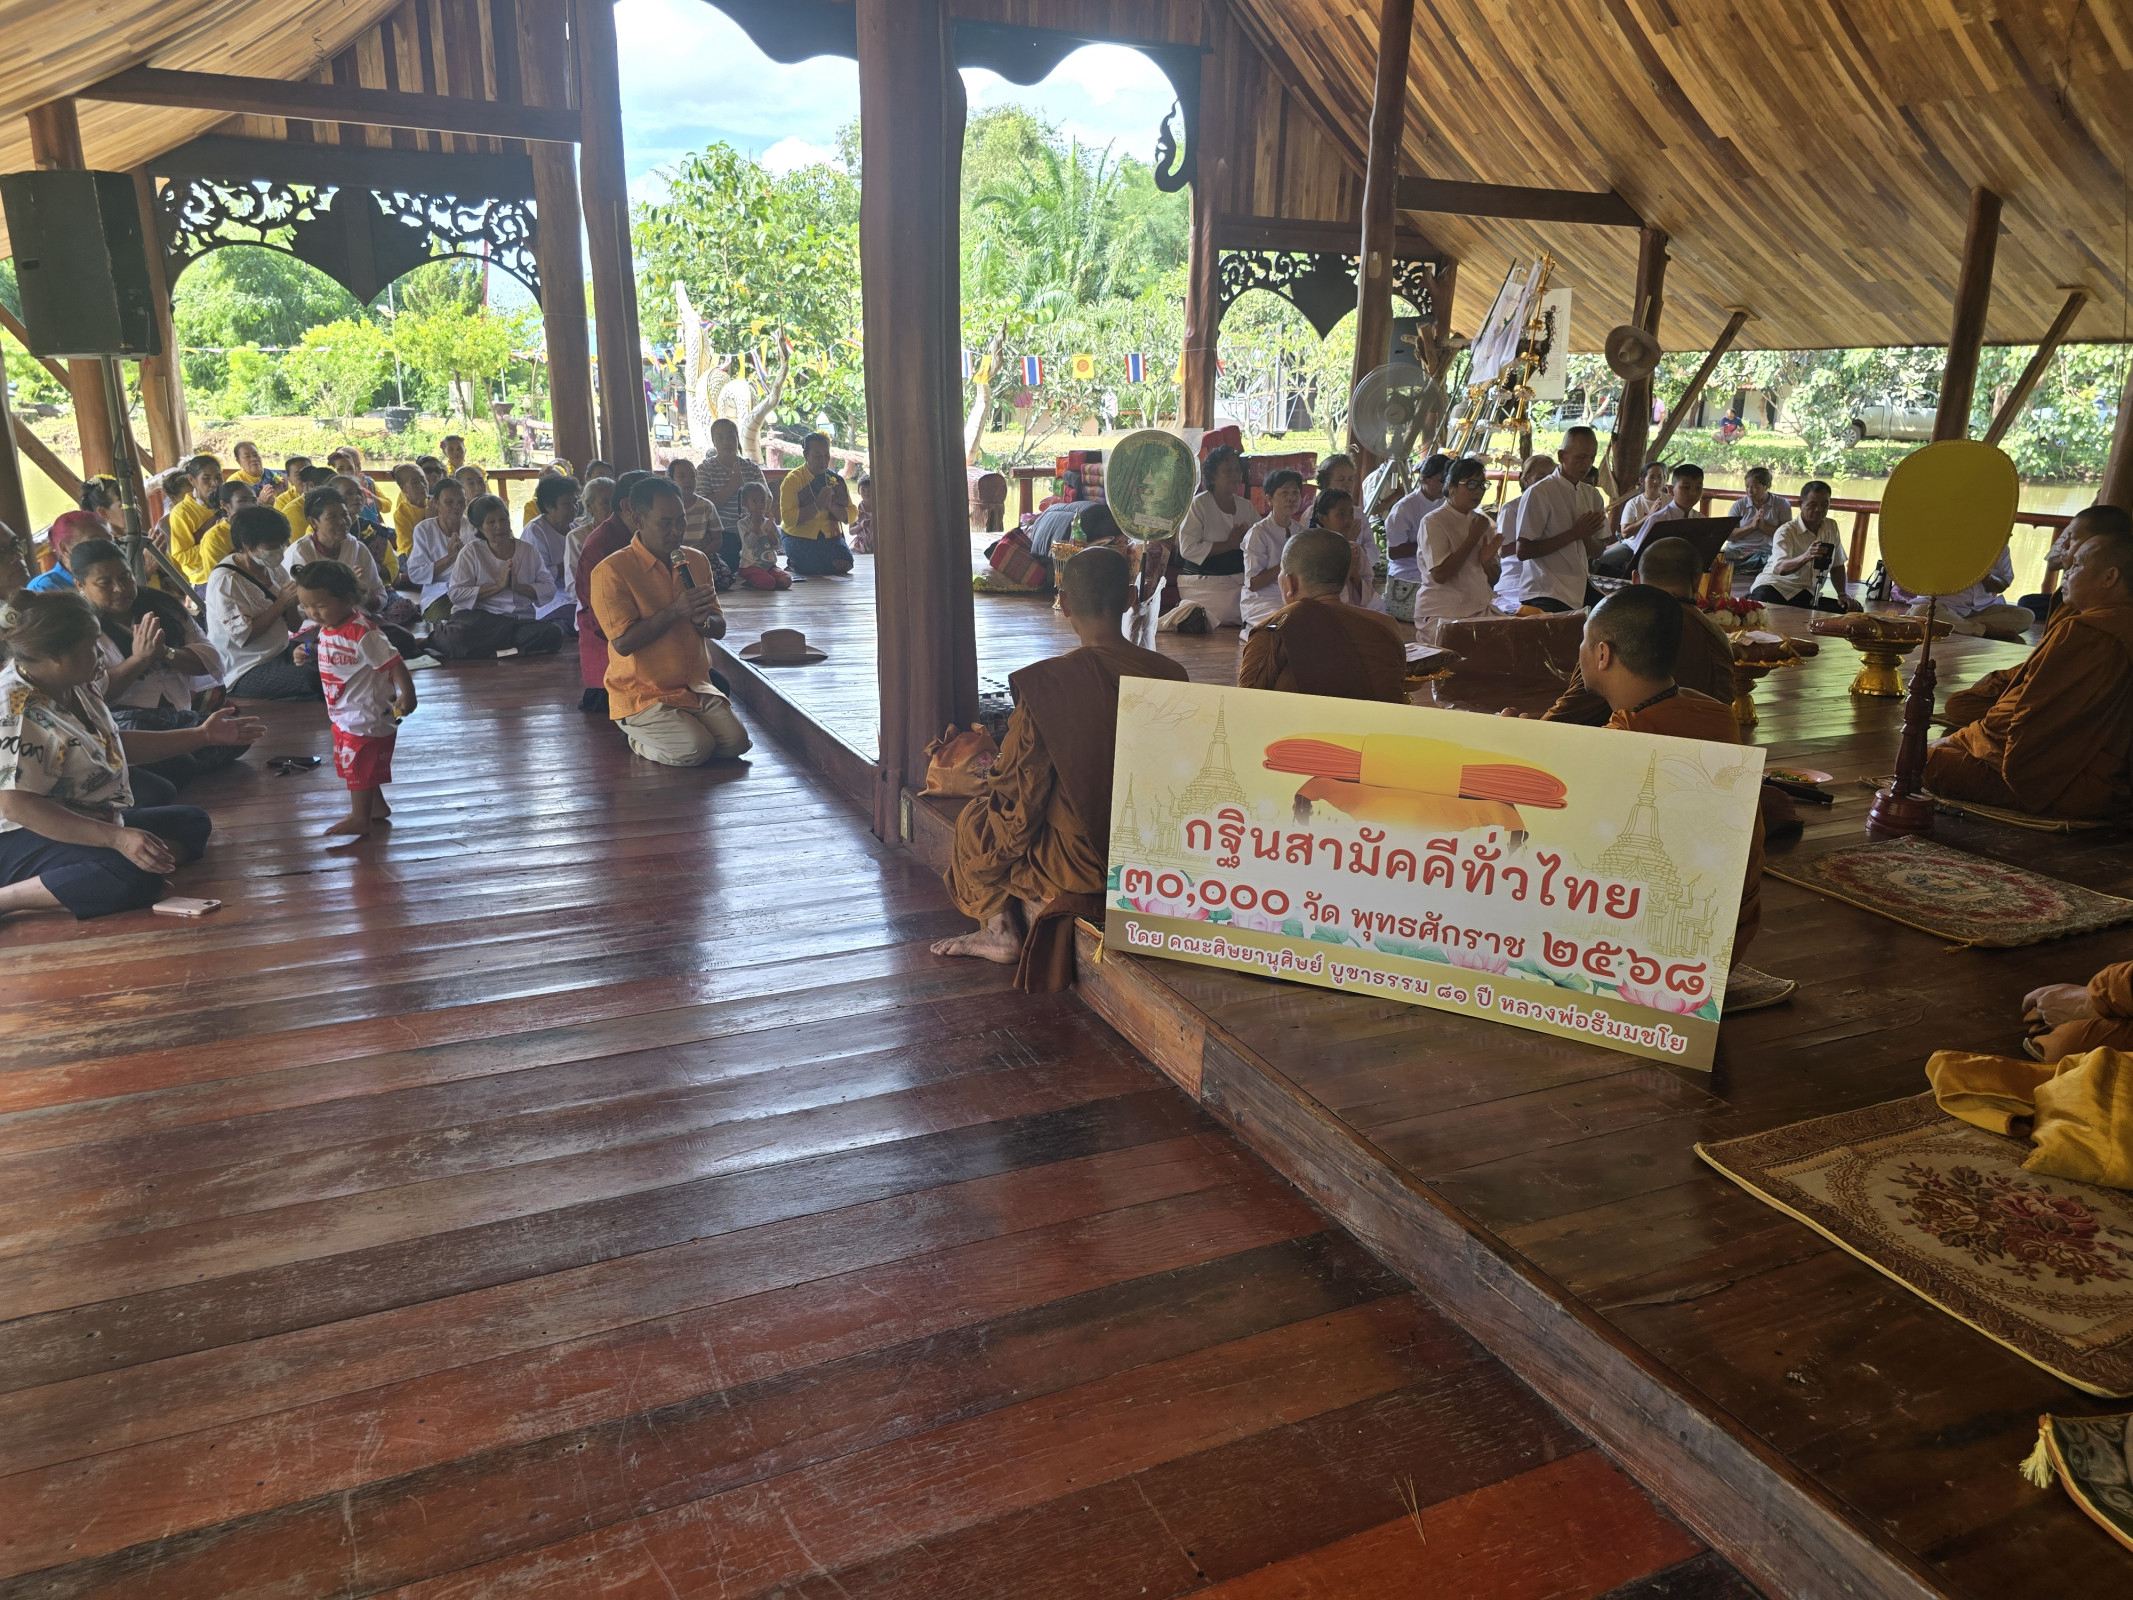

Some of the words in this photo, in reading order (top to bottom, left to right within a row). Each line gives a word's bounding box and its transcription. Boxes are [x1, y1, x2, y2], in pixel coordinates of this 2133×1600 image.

[1185, 807, 1641, 920] กฐินสามัคคีทั่วไทย
[1124, 867, 1290, 916] ๓๐,๐๐๐
[1302, 890, 1340, 926] วัด
[1351, 907, 1526, 959] พุทธศักราช
[1541, 931, 1707, 996] ๒๕๖๘
[1126, 924, 1162, 946] โดย
[1170, 934, 1323, 973] คณะศิษยานุศิษย์
[1330, 962, 1428, 995] บูชาธรรม
[1437, 986, 1467, 1003] ๘๑
[1477, 987, 1492, 1007] ปี
[1501, 995, 1686, 1052] หลวงพ่อธัมมชโย
